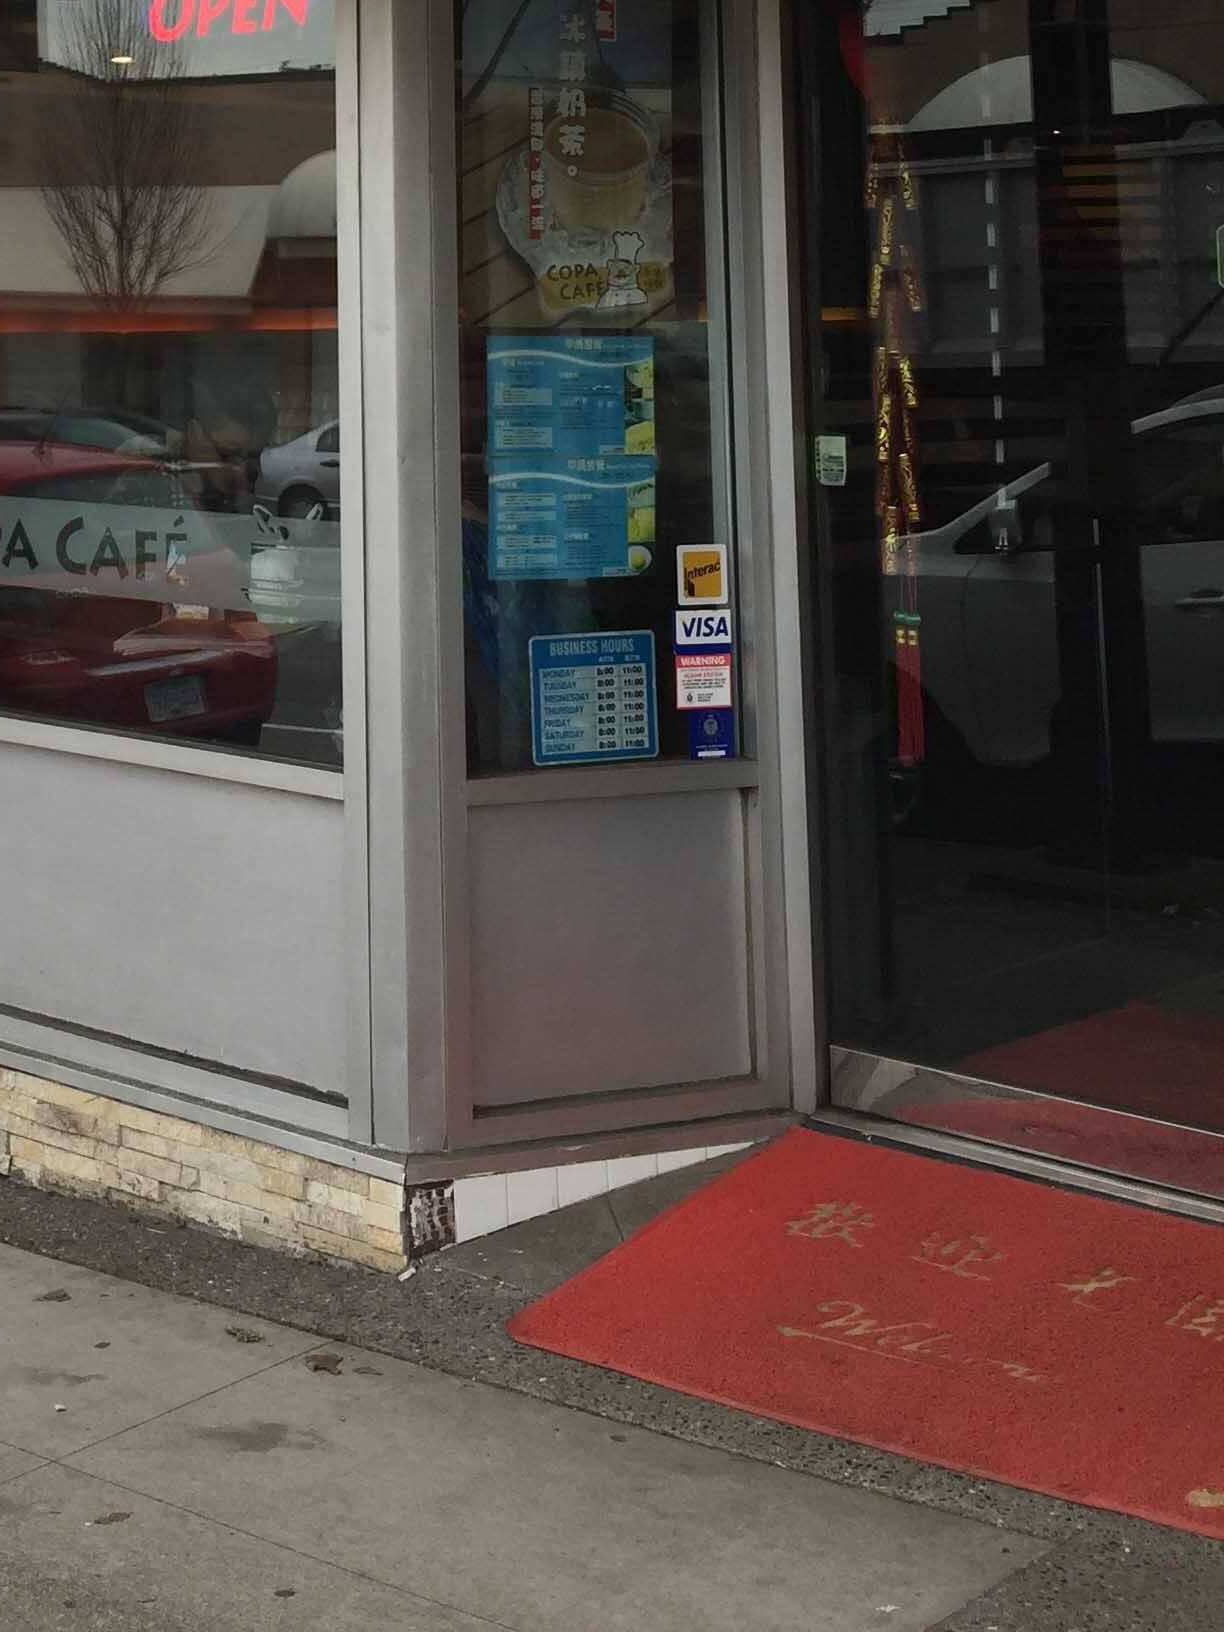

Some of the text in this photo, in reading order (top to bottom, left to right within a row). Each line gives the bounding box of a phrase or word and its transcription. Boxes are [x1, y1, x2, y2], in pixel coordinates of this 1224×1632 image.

[546, 263, 599, 282] COPA
[55, 515, 189, 585] CAFÉ
[683, 561, 721, 590] Interac
[681, 616, 729, 638] VISA
[549, 638, 634, 656] BUSINESS HOURS
[680, 656, 726, 666] WARNING
